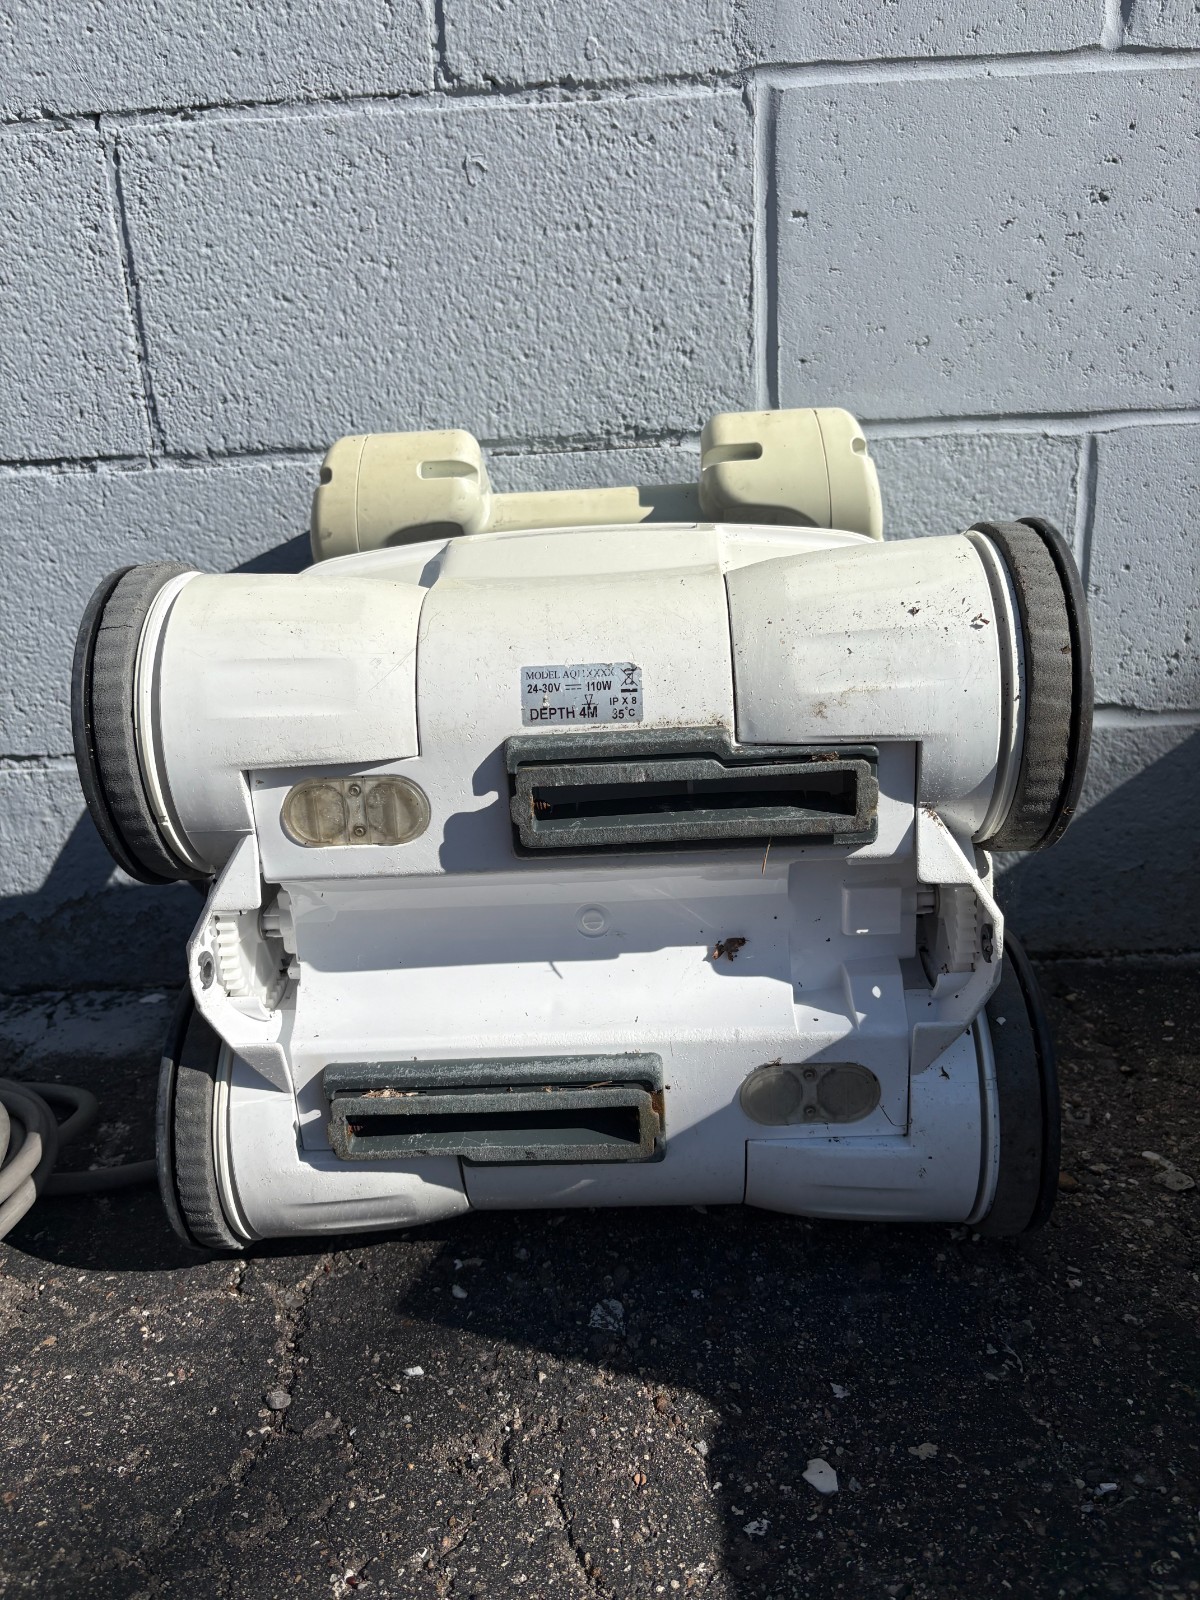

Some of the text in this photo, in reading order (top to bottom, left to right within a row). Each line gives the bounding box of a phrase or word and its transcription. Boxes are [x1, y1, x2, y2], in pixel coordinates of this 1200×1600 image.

[525, 670, 560, 680] MODEL
[527, 681, 612, 694] 24-30V 110W
[609, 696, 637, 705] IP X 8
[530, 705, 598, 720] DEPTH 4M
